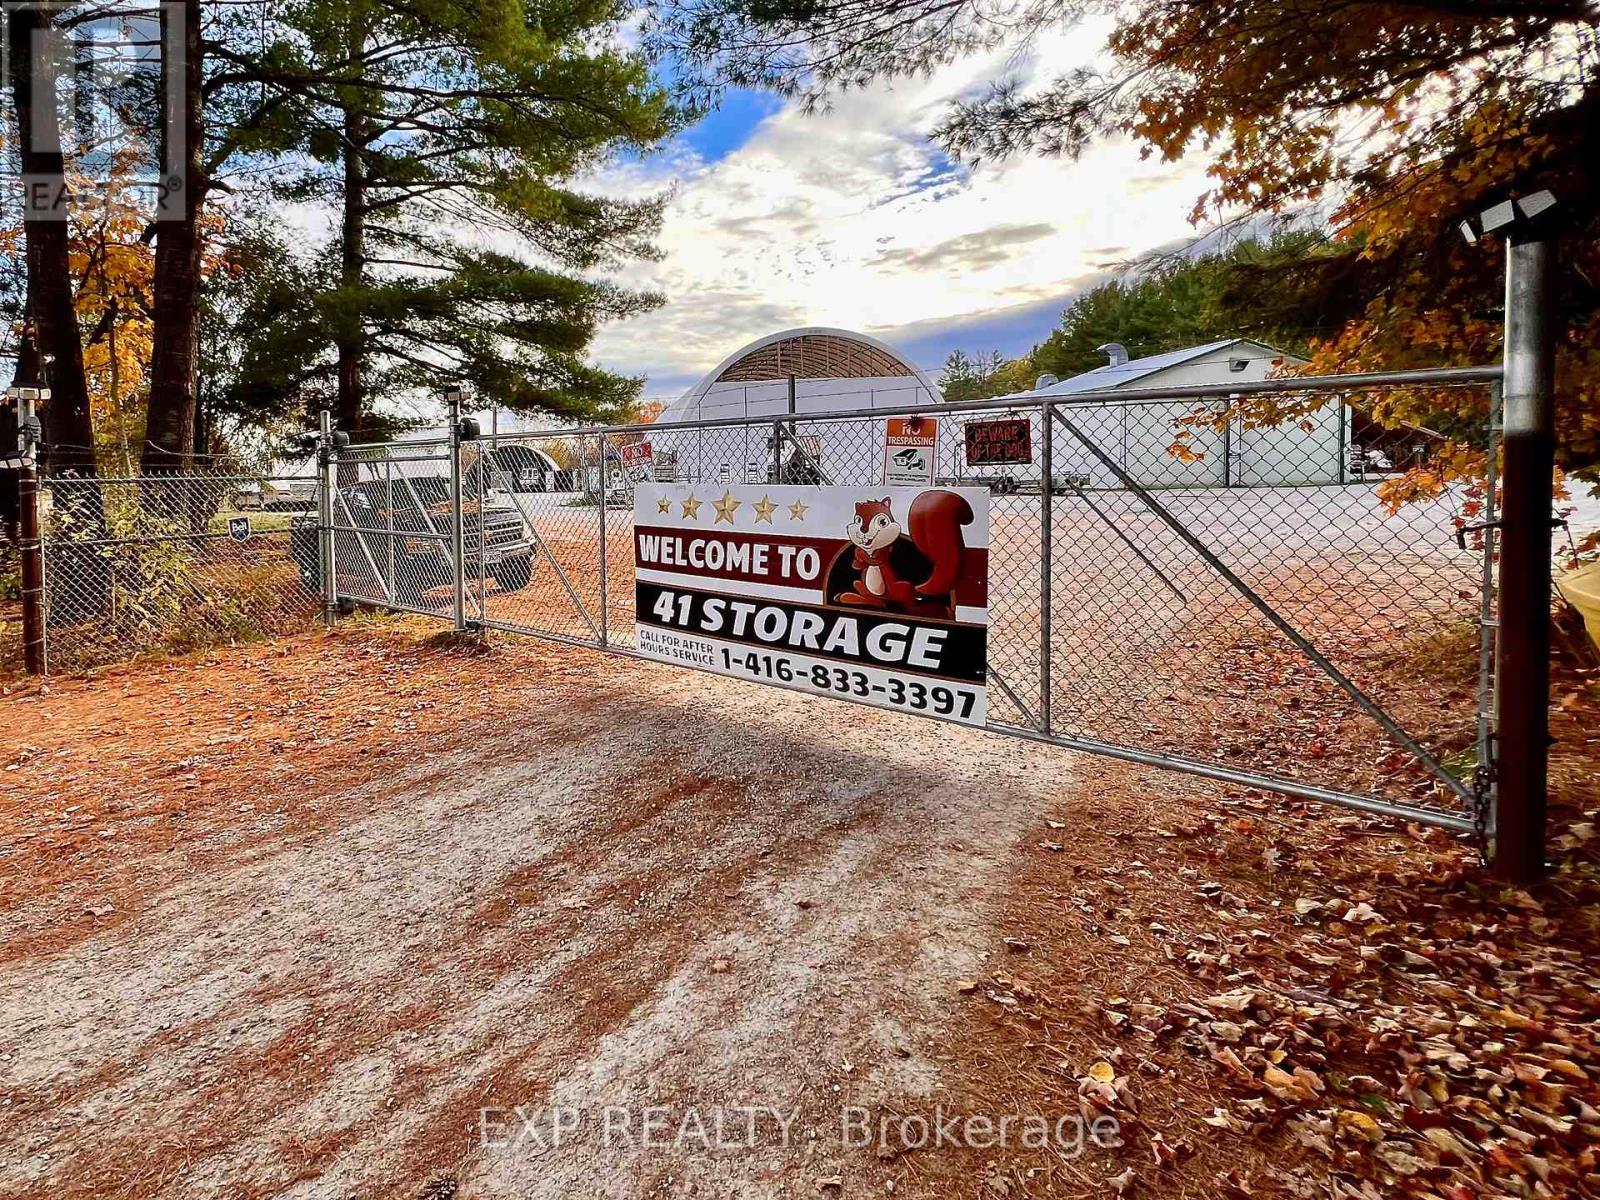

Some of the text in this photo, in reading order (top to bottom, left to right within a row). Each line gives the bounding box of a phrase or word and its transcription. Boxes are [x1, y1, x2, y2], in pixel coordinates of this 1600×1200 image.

[888, 436, 935, 446] TRESPASSING
[639, 534, 820, 580] WELCOME TO
[640, 629, 713, 655] CALL FOR AFTER
[653, 590, 948, 669] 41 STORAGE
[640, 641, 715, 666] HOURS SERVICE
[721, 647, 976, 719] 1-416-833-3397
